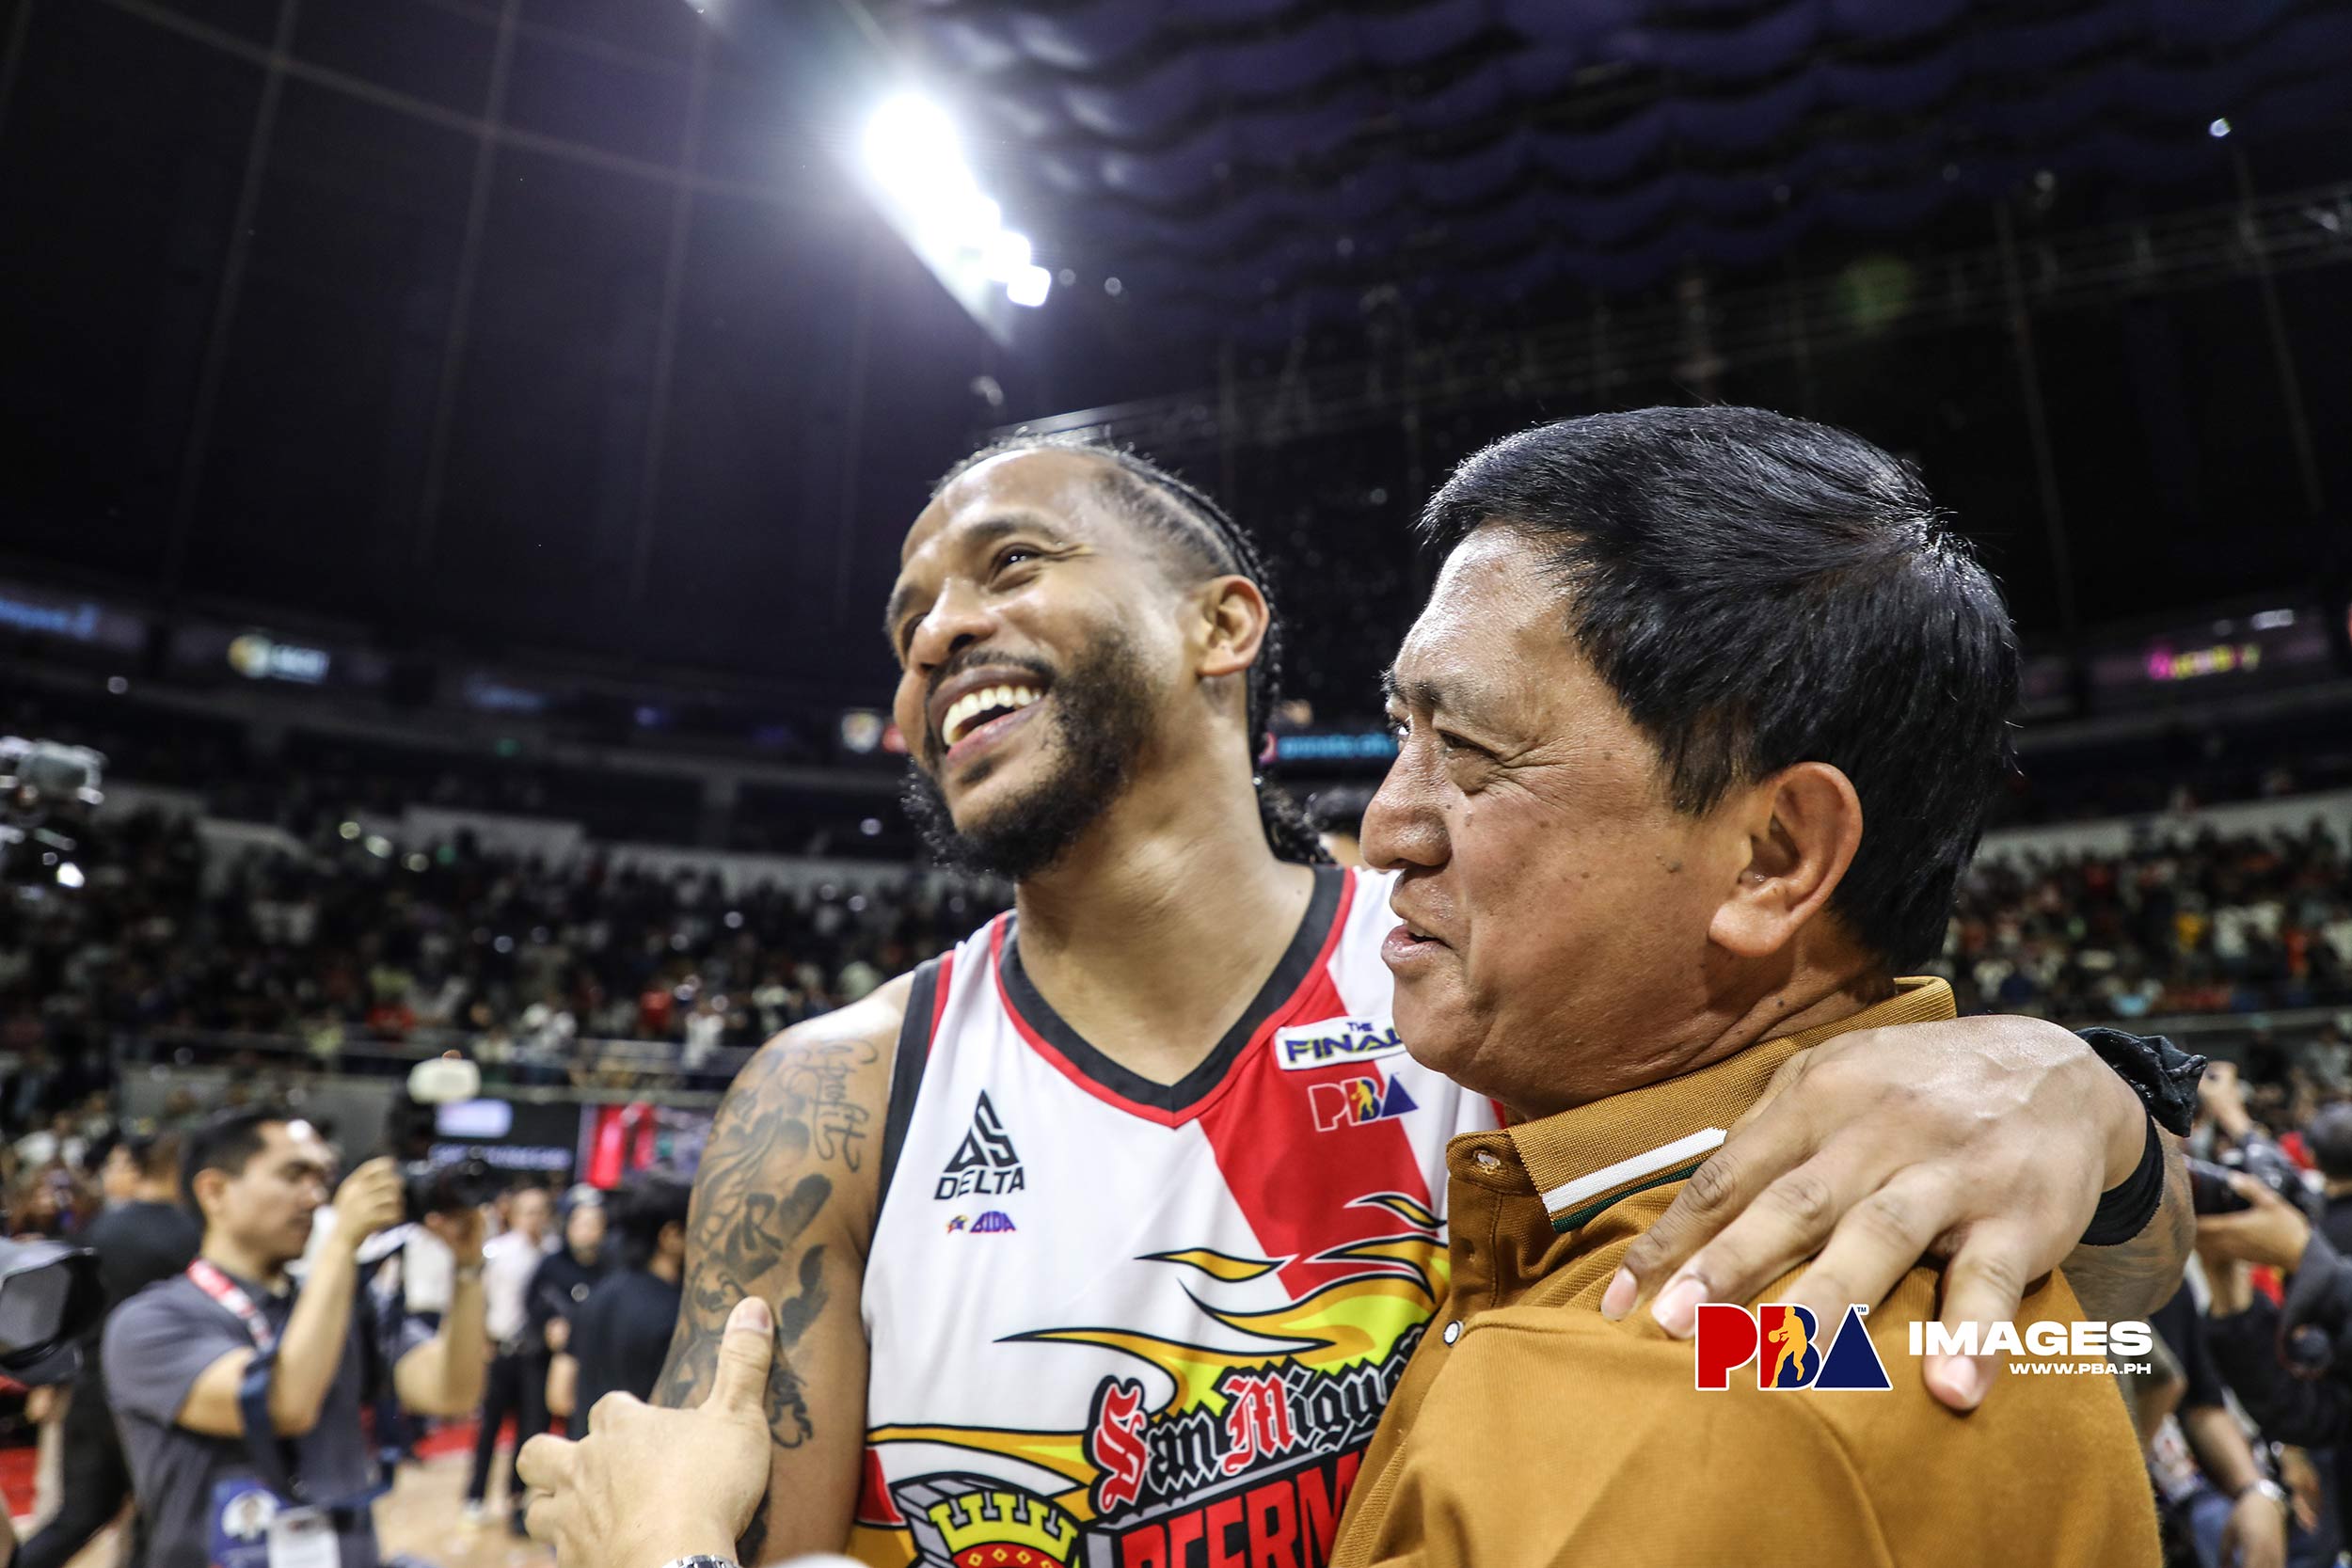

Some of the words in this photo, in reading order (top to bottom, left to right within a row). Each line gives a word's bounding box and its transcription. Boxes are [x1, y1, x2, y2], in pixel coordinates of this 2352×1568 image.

[1347, 1022, 1374, 1032] THE
[1308, 1073, 1419, 1132] PBA
[933, 1166, 1025, 1200] DELTA
[1091, 1381, 1222, 1514] San
